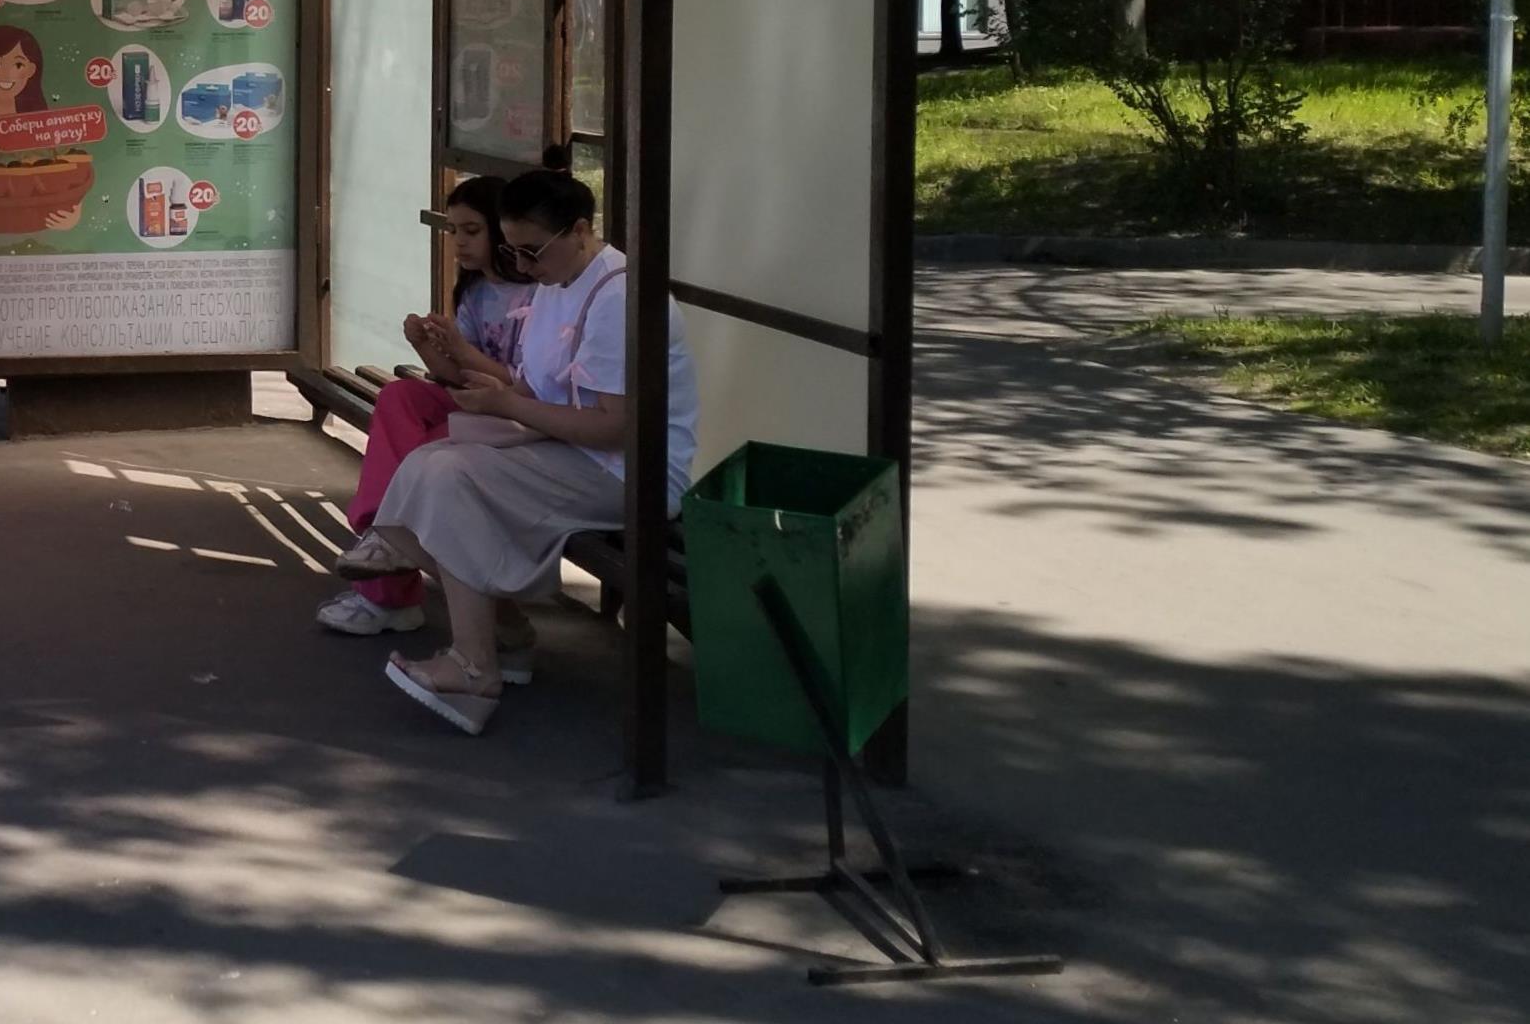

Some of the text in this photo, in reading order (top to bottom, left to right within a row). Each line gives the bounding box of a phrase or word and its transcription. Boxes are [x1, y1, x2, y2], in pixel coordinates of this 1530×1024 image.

[46, 110, 103, 127] аптечку
[35, 123, 88, 144] на дачу!
[189, 291, 281, 319] НЕОБХОДИМО
[61, 322, 174, 348] КОНСУЛЬТАЦИИ
